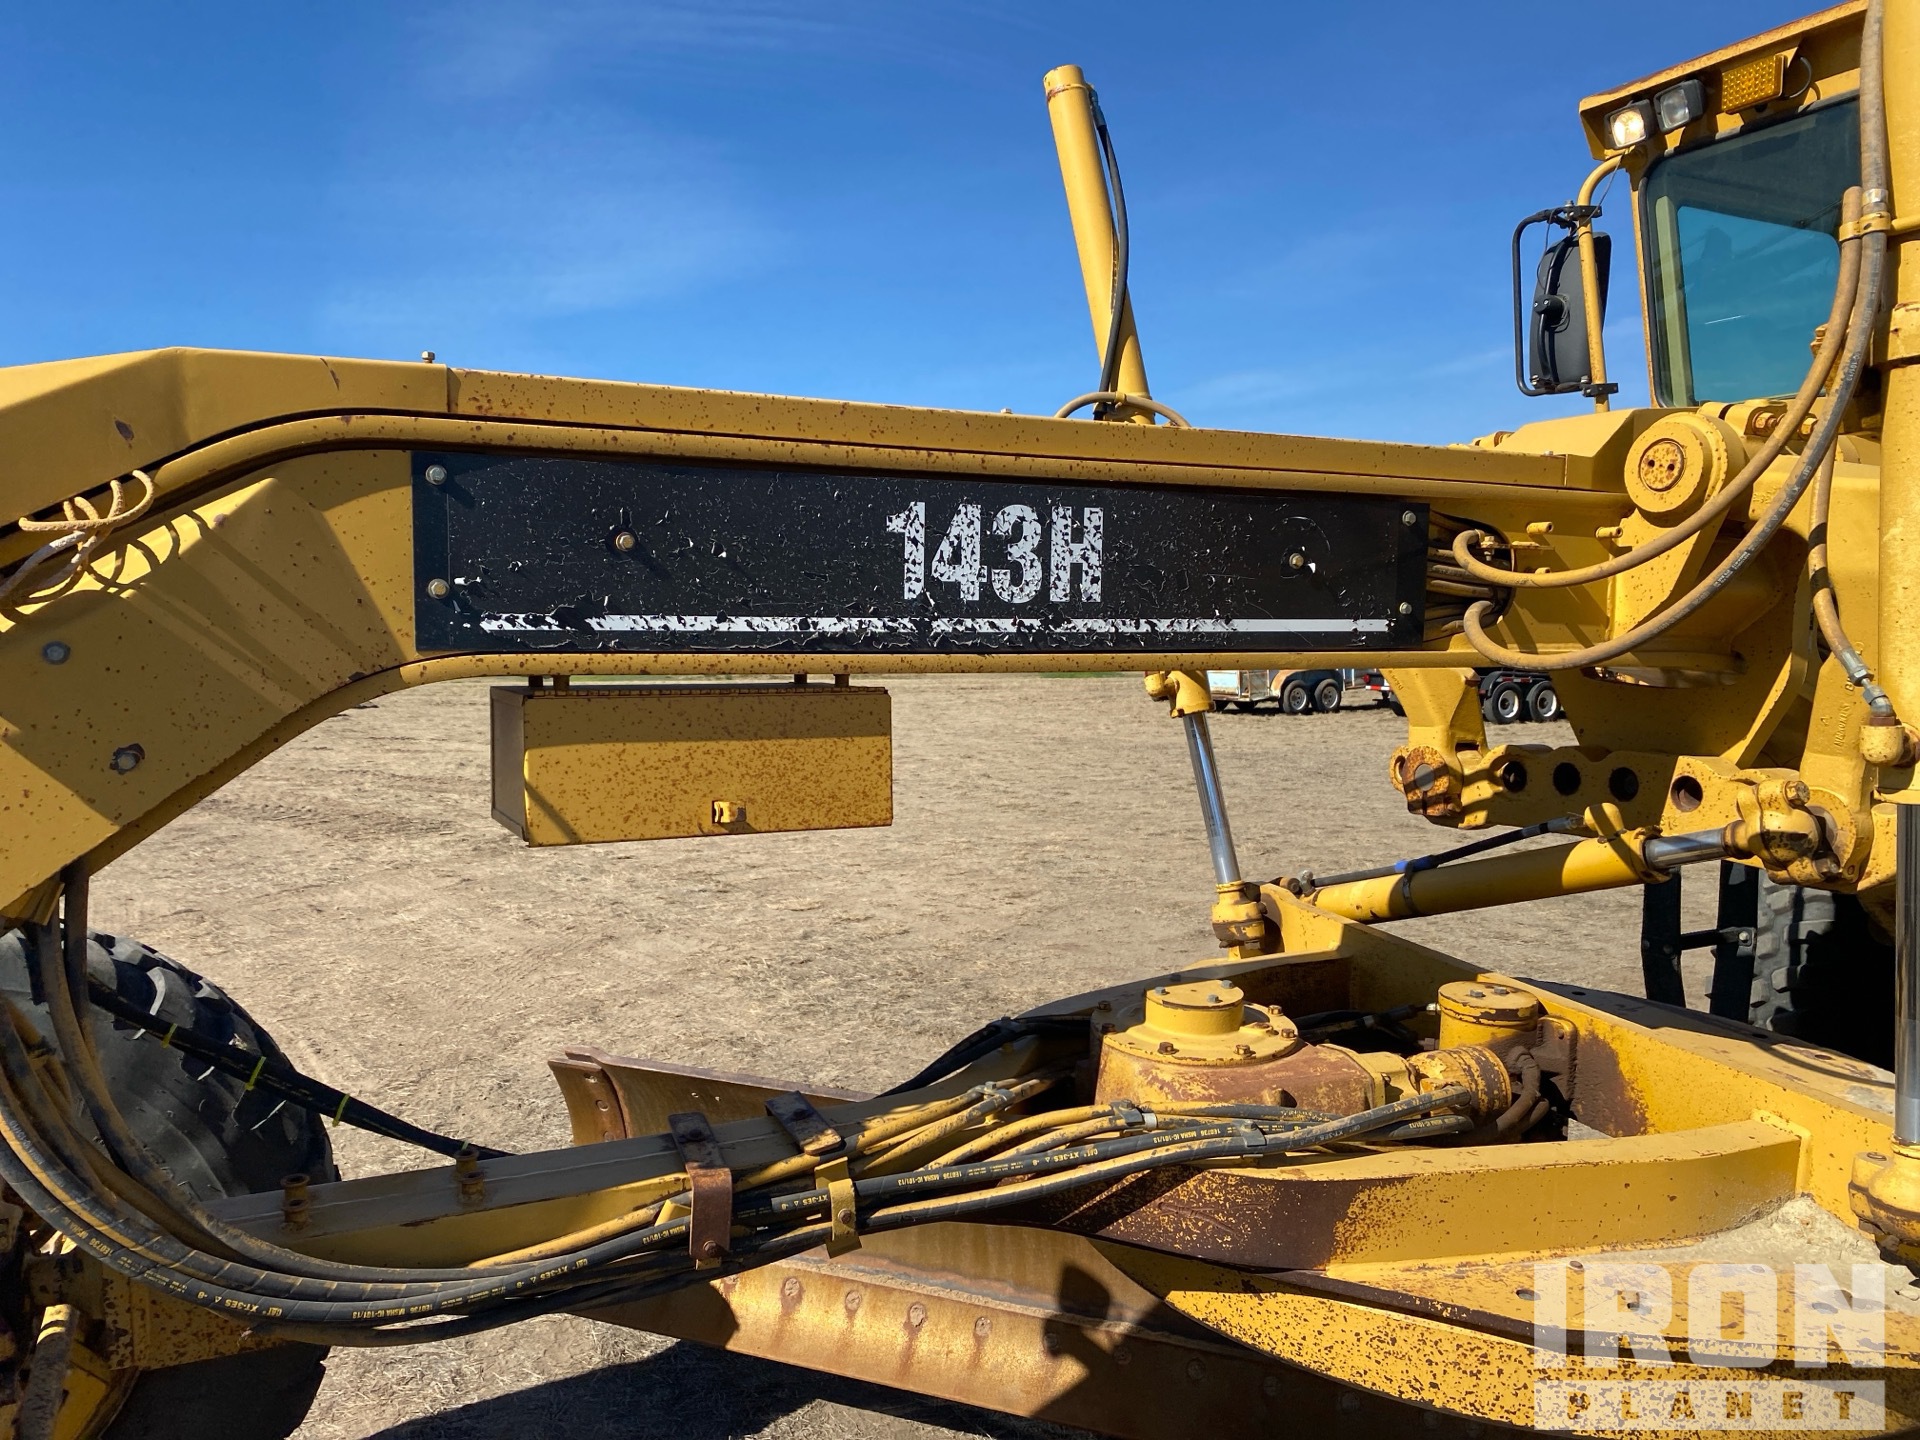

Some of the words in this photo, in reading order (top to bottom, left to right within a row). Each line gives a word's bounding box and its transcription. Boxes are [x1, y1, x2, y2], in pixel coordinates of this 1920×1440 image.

[886, 501, 1104, 604] 143H
[1152, 1133, 1180, 1144] IC-101/13
[1179, 1130, 1197, 1140] MSHA
[1032, 1158, 1040, 1166] -8
[1053, 1151, 1080, 1162] XT-3ES
[896, 1175, 924, 1186] IC-101/13
[802, 1194, 828, 1206] XT-3ES
[780, 1203, 789, 1211] -8
[642, 1229, 669, 1245] IC-101/13
[88, 1237, 114, 1257] 1E0736
[539, 1265, 568, 1281] XT-3ES
[515, 1280, 525, 1289] -8
[197, 1290, 209, 1300] -8
[224, 1299, 260, 1314] XT-3ES
[265, 1306, 283, 1318] CAT
[385, 1307, 406, 1317] MSHA
[409, 1303, 433, 1314] 1E0736
[352, 1309, 386, 1320] IC-101/13
